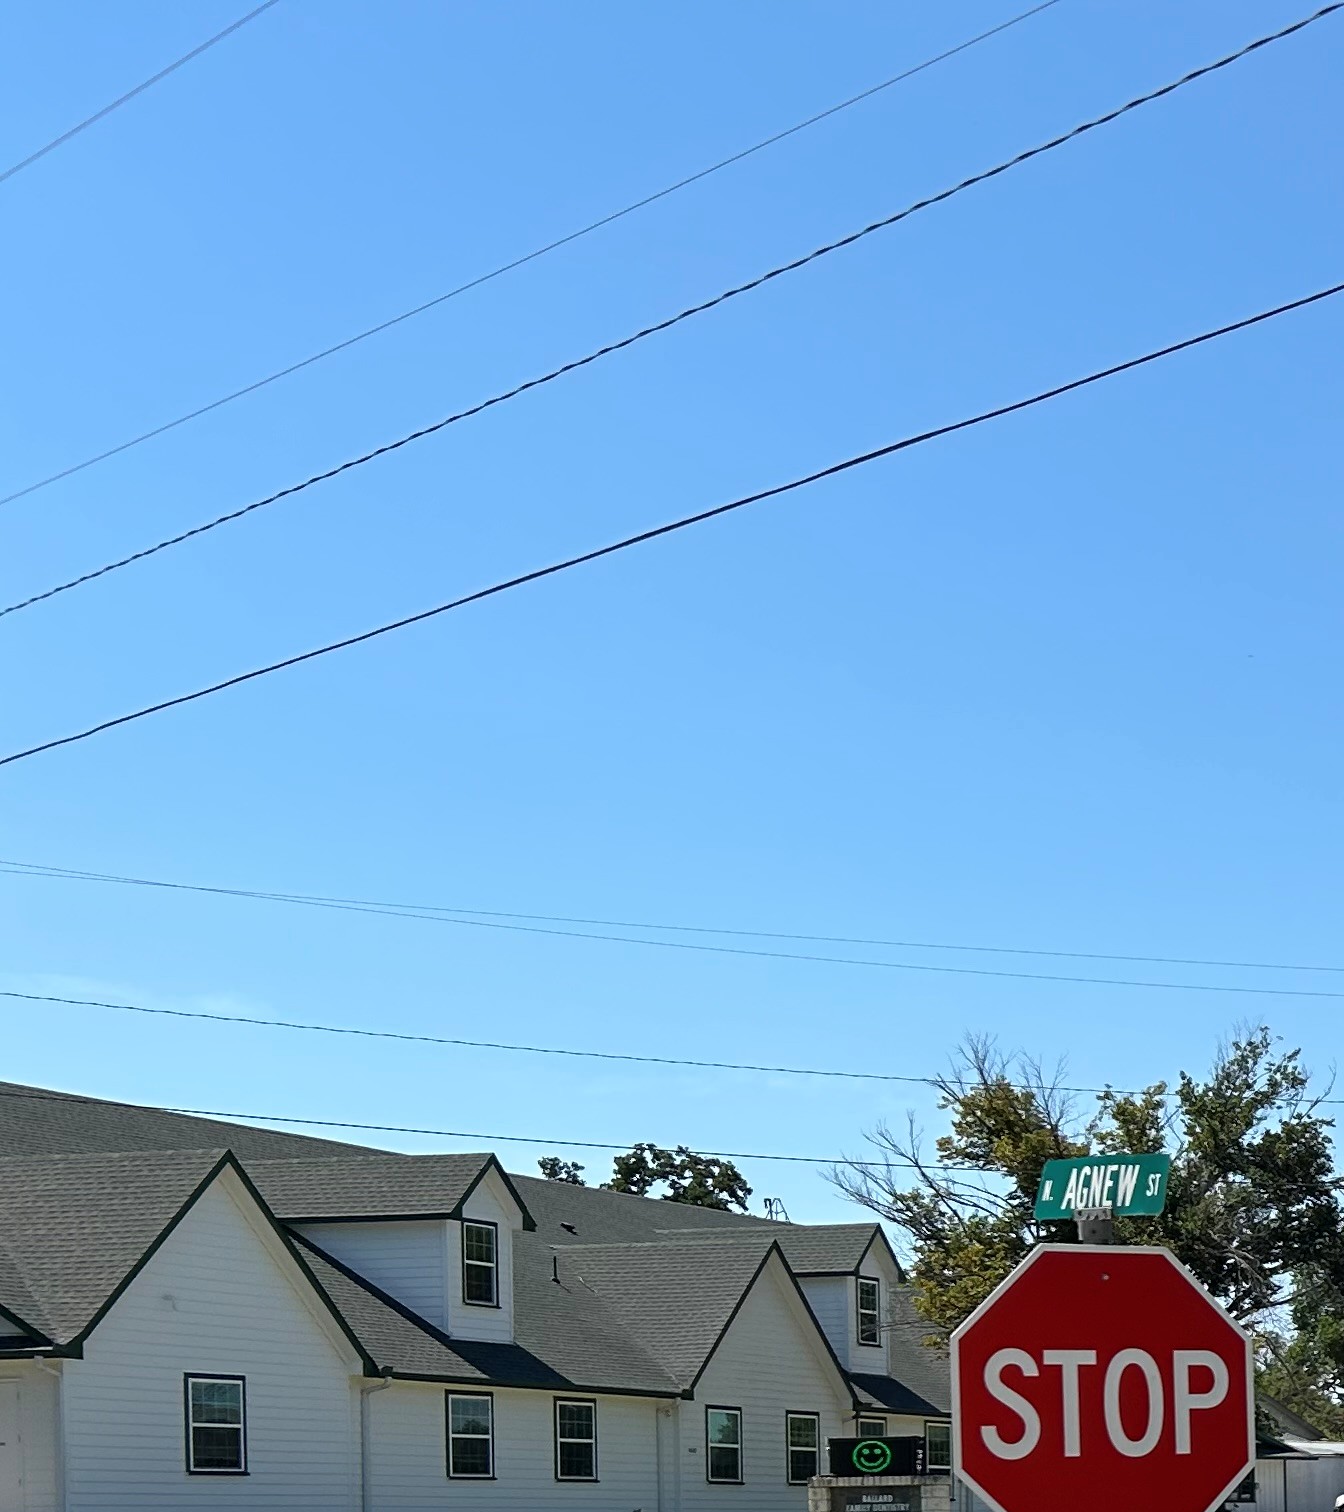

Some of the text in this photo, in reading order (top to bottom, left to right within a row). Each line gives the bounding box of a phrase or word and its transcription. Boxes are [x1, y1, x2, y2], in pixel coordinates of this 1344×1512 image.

[1041, 1164, 1162, 1210] N. AGNEW ST
[980, 1347, 1230, 1461] STOP
[846, 1503, 909, 1512] FAMILY DENTISTRY
